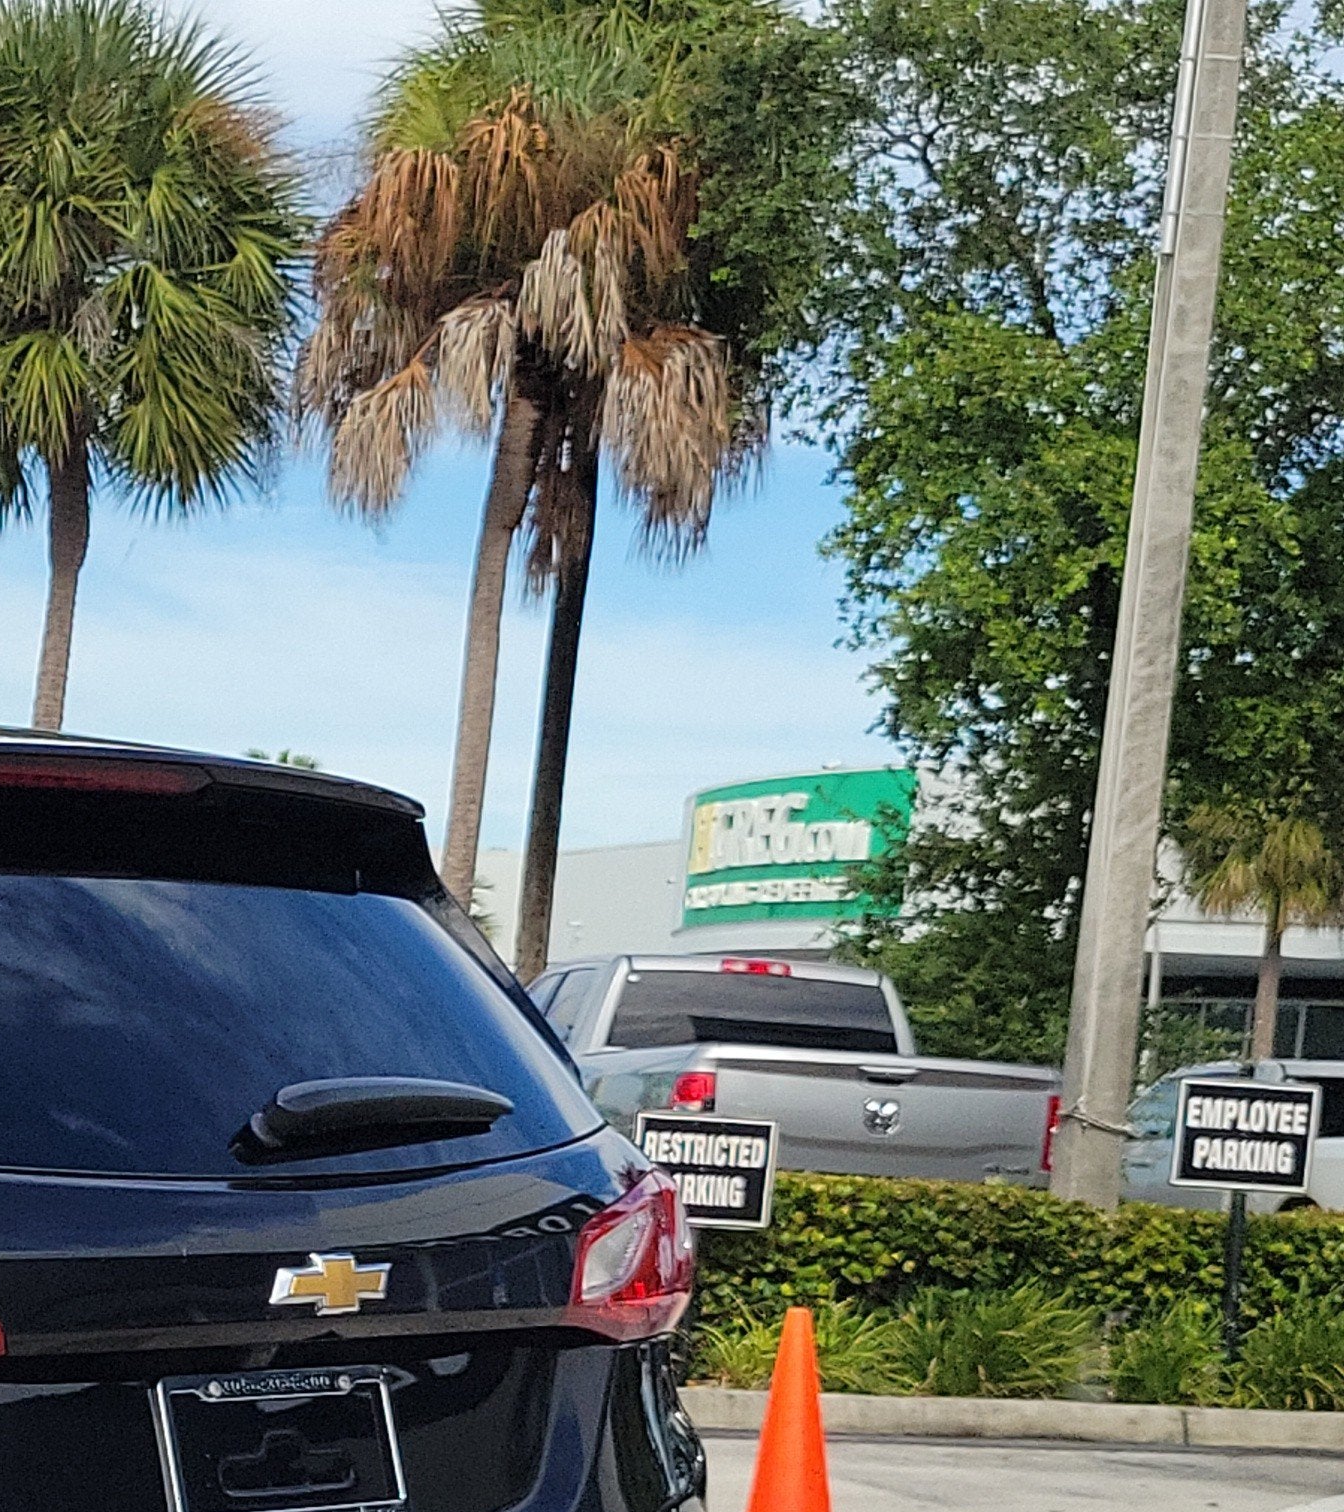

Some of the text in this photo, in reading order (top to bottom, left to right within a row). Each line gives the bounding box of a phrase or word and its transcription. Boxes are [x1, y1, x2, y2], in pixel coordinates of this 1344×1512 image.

[1186, 1095, 1310, 1136] EMPLOYEE
[643, 1129, 767, 1169] RESTRICTED
[1191, 1136, 1297, 1175] PARKING
